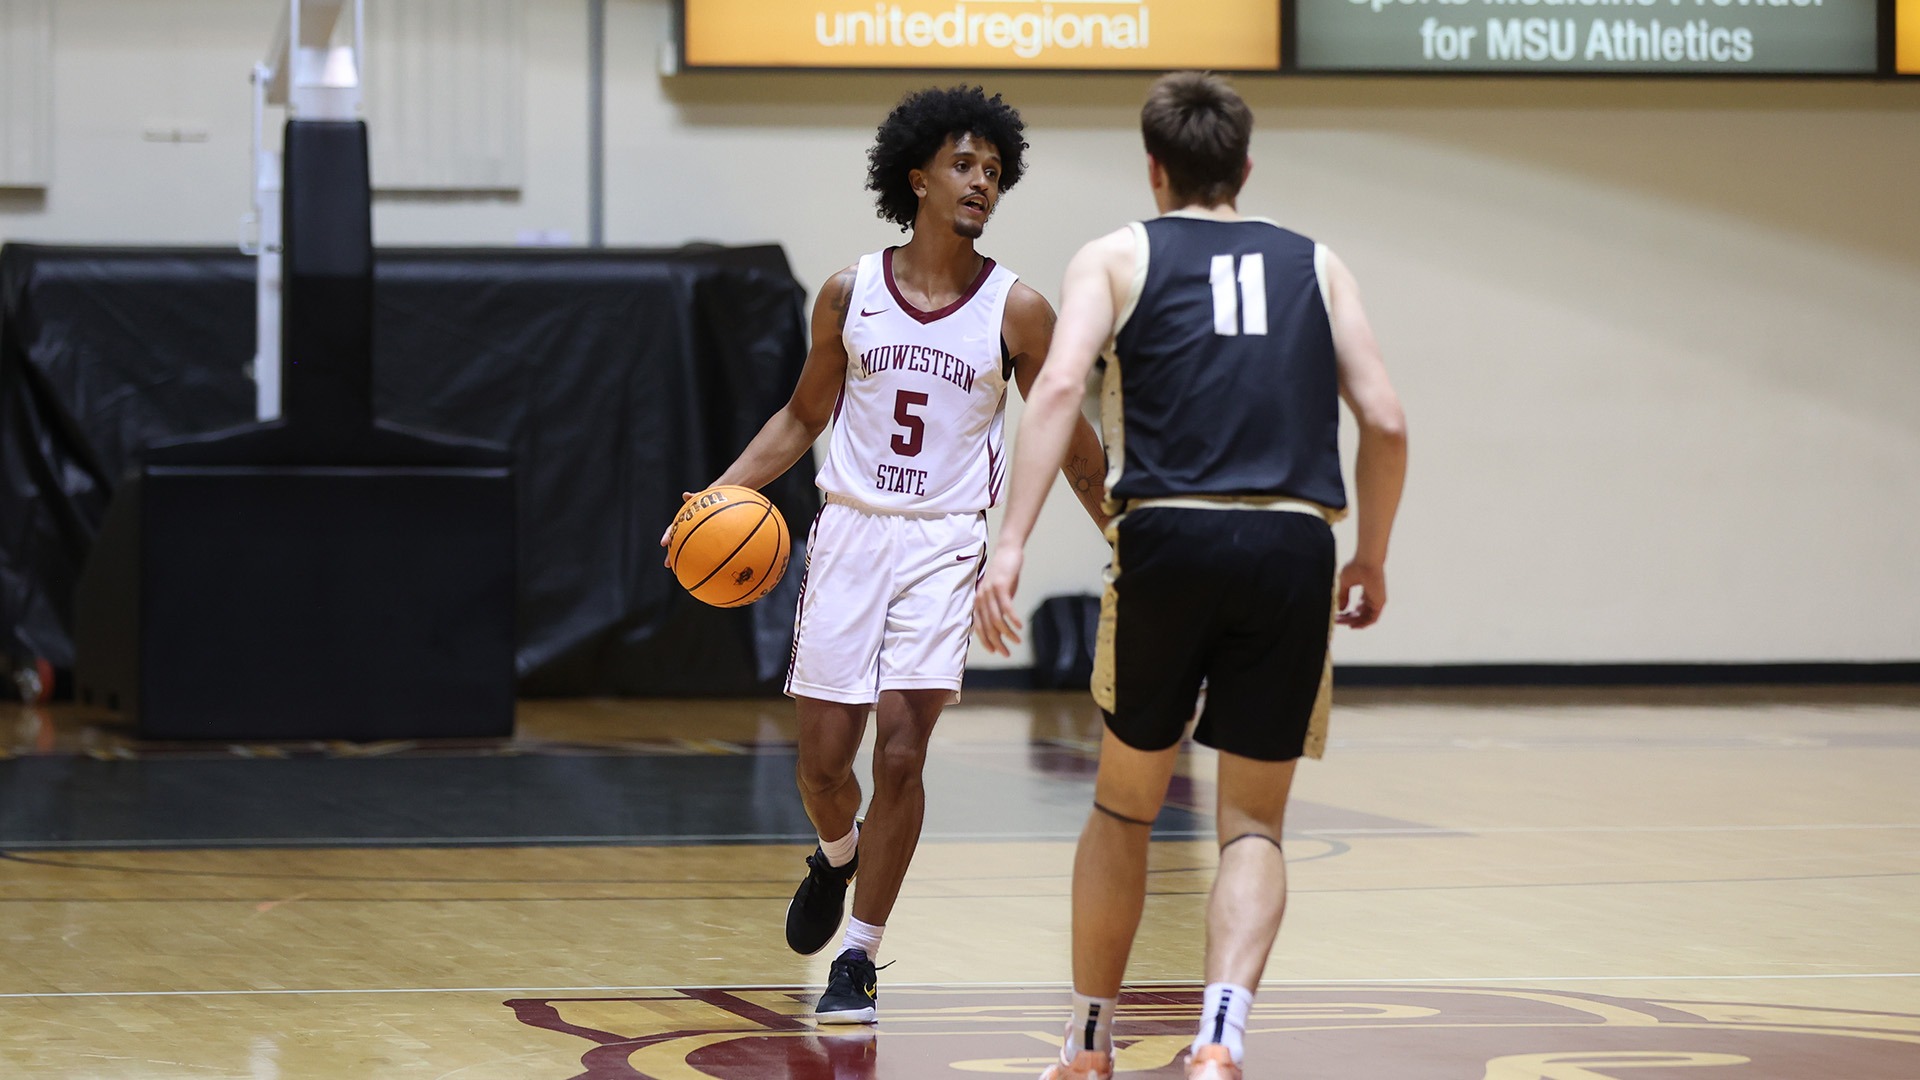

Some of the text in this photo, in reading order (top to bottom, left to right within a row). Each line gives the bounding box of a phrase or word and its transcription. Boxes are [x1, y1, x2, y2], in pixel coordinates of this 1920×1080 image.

[815, 4, 1148, 58] unitedregional
[1419, 17, 1753, 62] for MSU Athletics
[1208, 252, 1268, 336] 11
[860, 344, 976, 395] MIDWESTERN
[890, 389, 929, 458] 5
[876, 464, 928, 497] STATE
